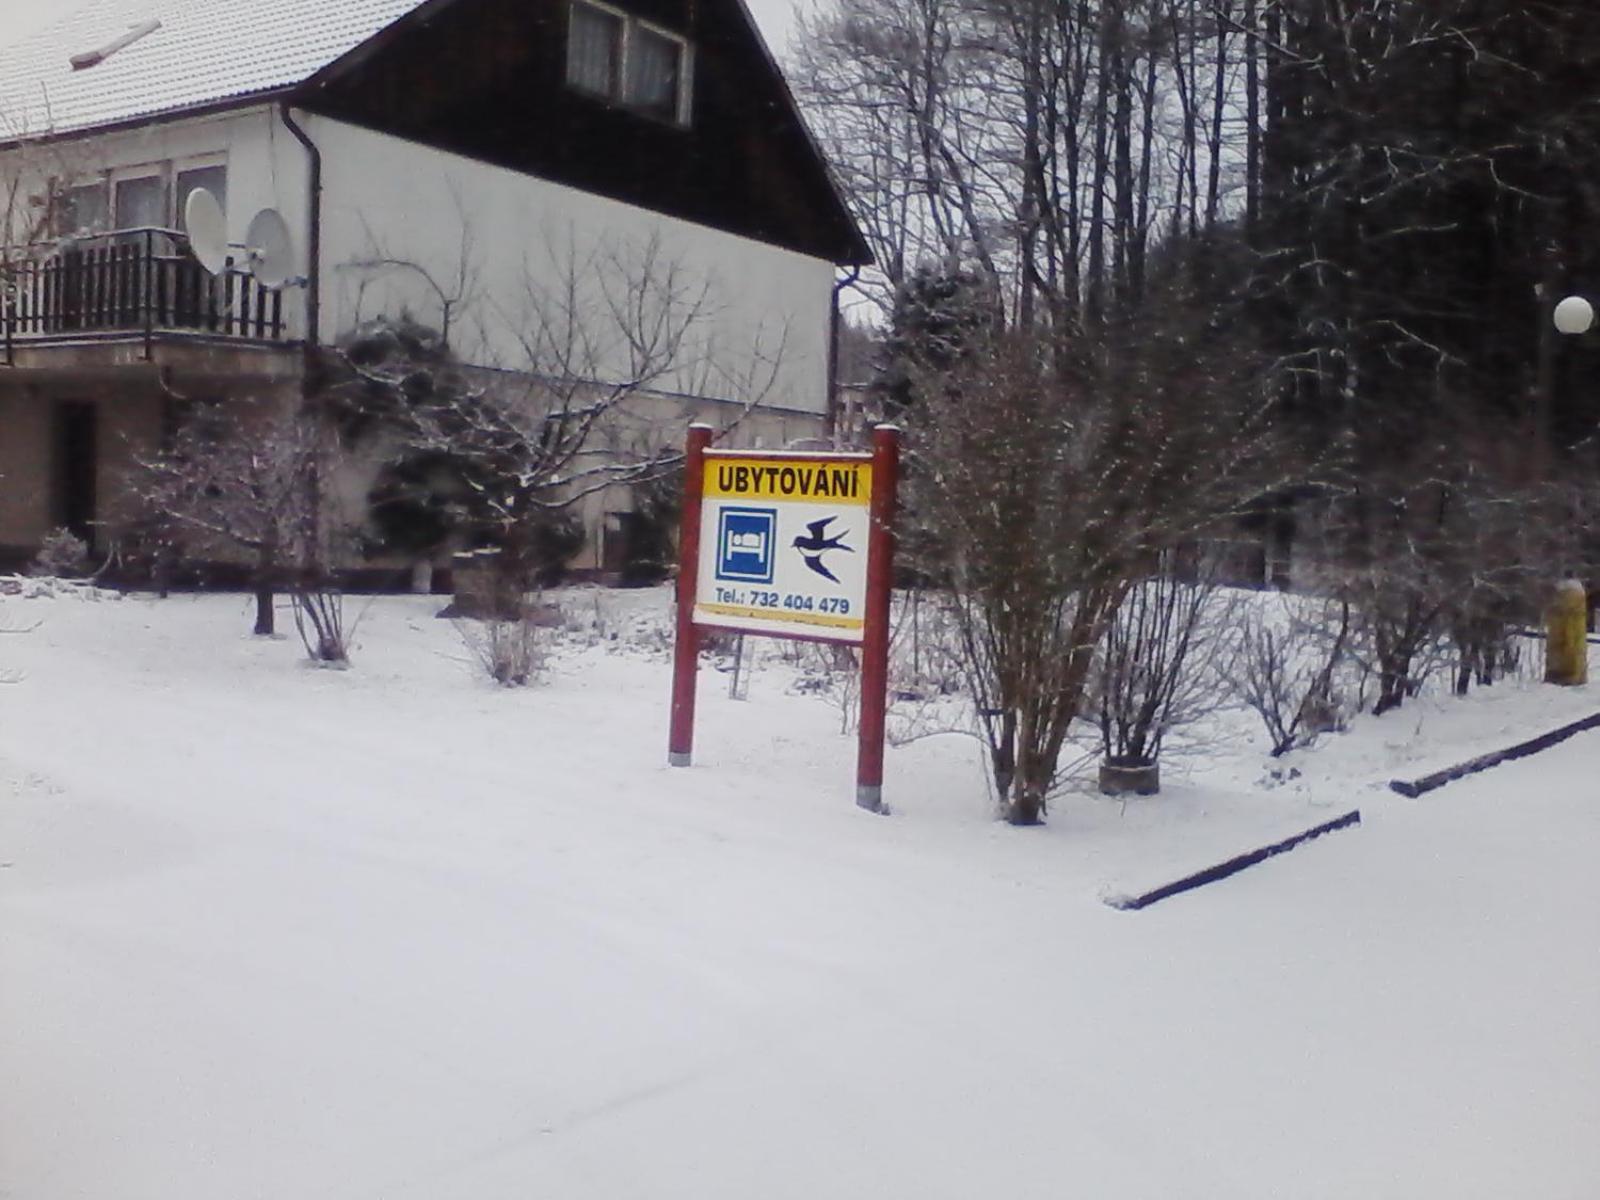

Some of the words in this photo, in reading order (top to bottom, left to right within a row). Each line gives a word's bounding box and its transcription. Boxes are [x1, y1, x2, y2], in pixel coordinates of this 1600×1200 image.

[719, 464, 859, 497] UBYTOVÁNÍ
[716, 587, 744, 604] Tel.:
[750, 590, 779, 607] 732
[784, 594, 813, 611] 404
[819, 598, 849, 614] 479
